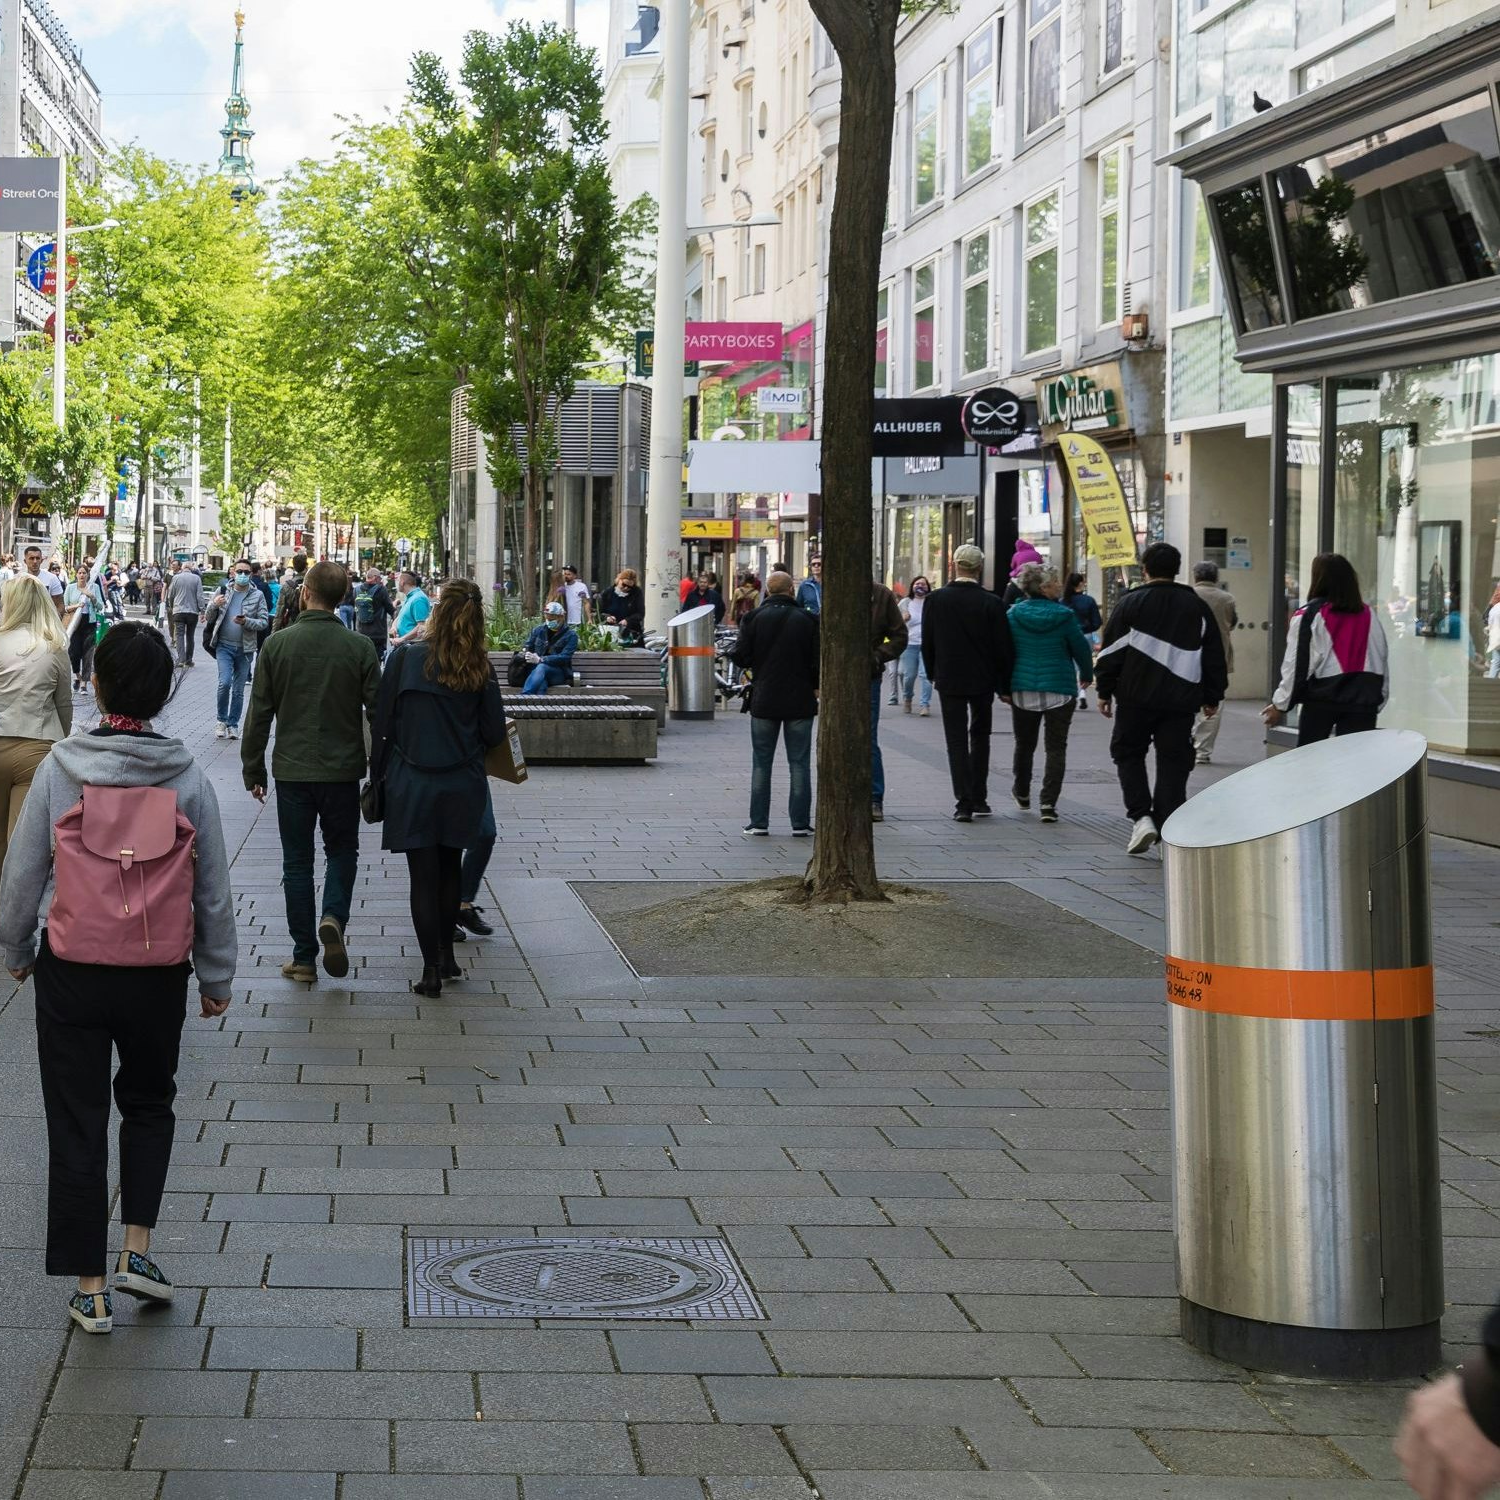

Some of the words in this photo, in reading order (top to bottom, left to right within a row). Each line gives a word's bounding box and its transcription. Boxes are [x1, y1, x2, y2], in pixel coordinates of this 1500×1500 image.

[2, 188, 36, 199] Street
[684, 335, 776, 349] PARTYBOXES
[772, 393, 800, 402] MDI
[873, 421, 942, 433] ALLHUBER
[1092, 520, 1122, 535] VANS
